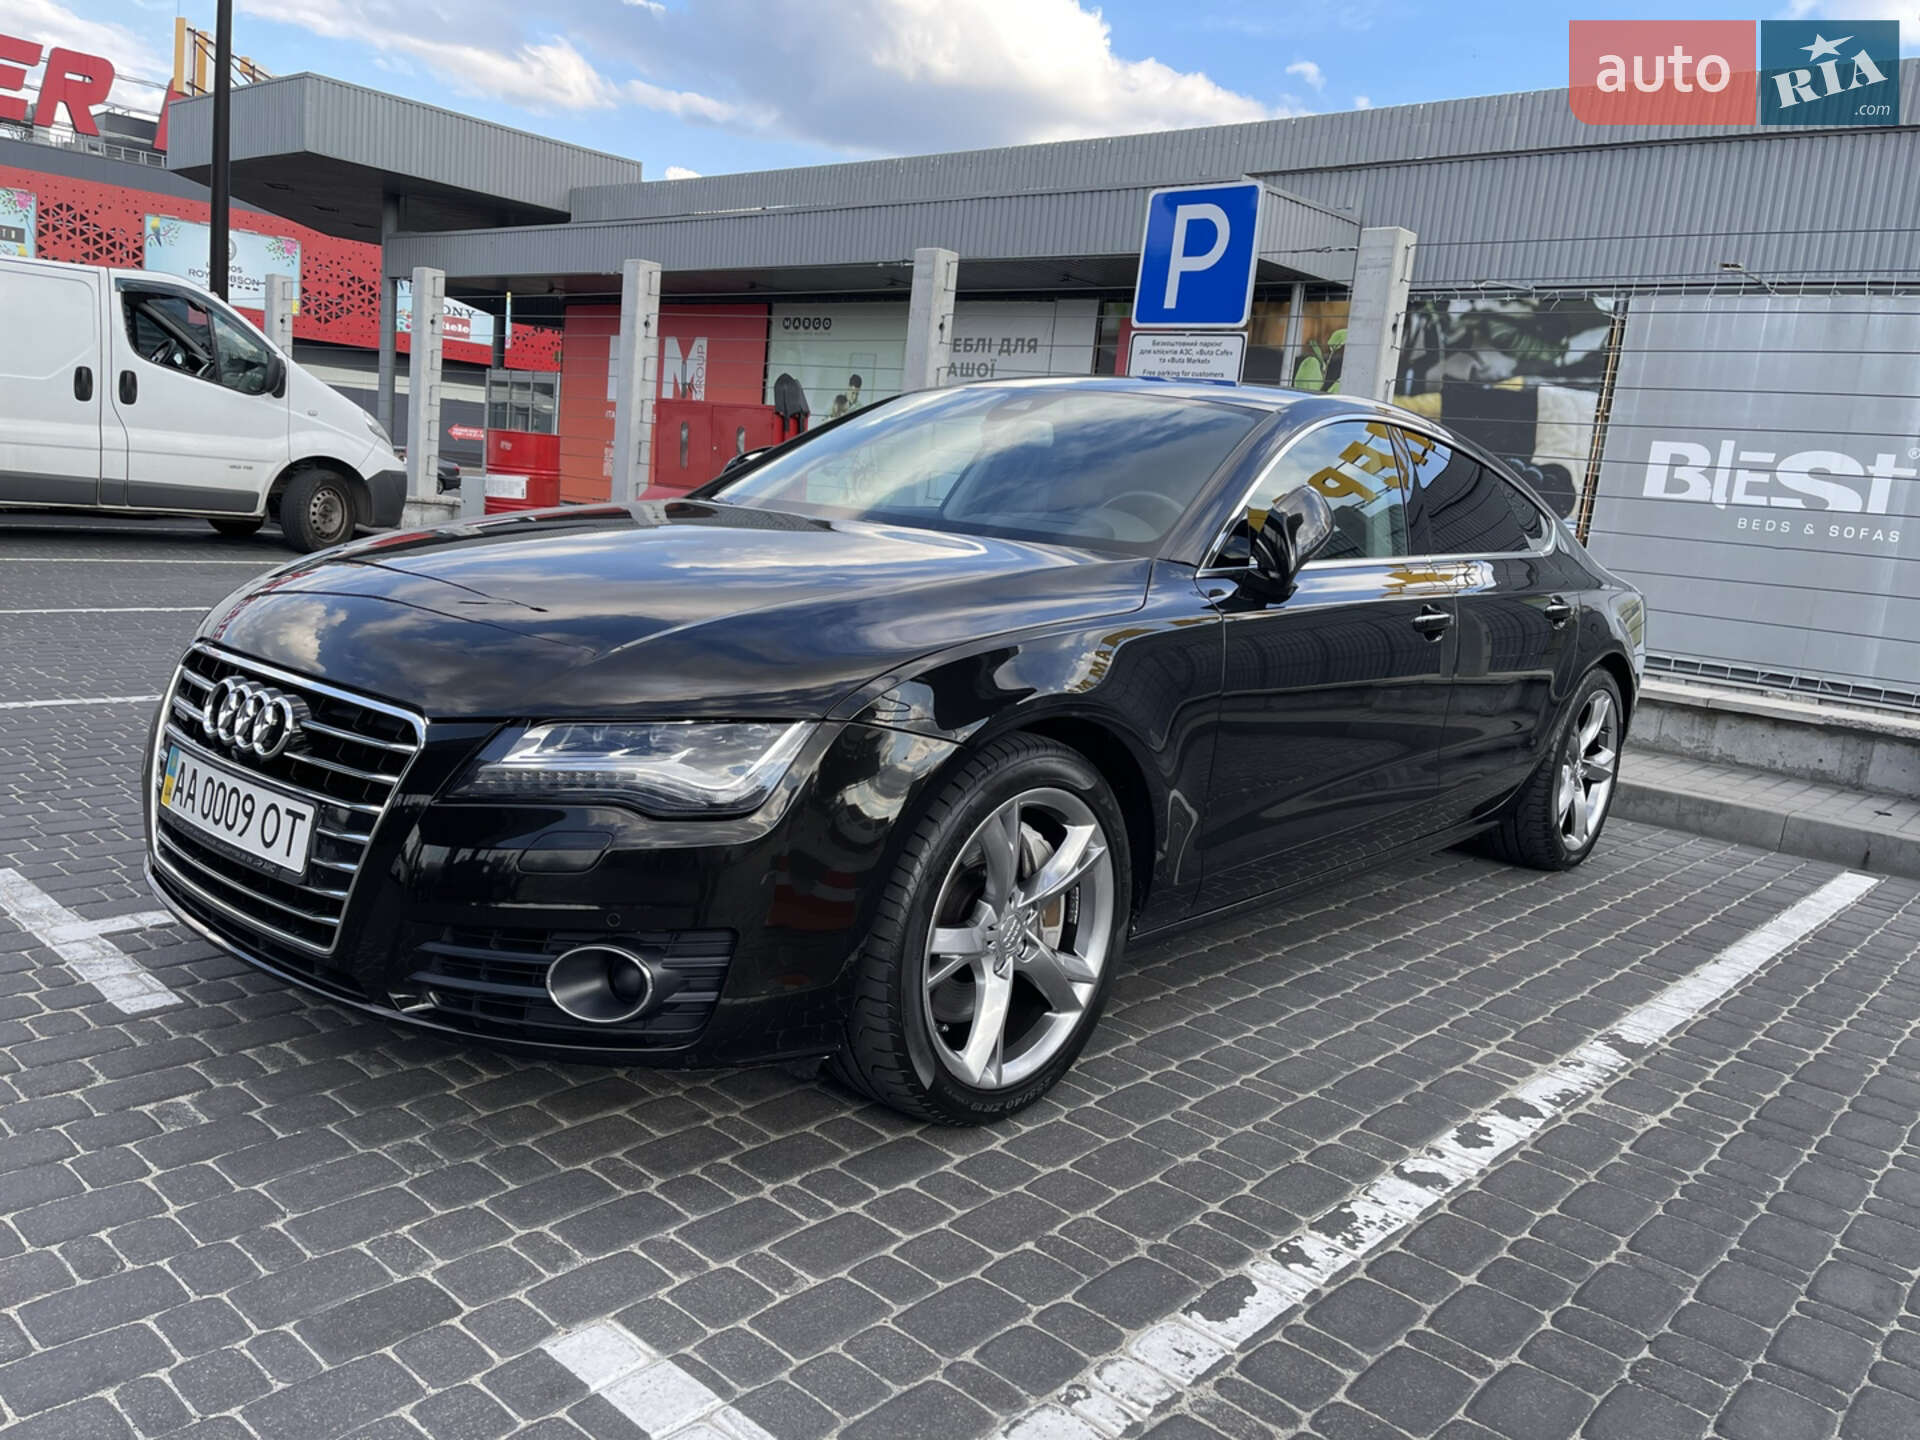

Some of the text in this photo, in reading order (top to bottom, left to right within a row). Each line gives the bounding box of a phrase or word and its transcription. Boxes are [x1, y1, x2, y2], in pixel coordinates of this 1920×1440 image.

[1163, 203, 1231, 309] P
[443, 304, 476, 319] ONY
[952, 337, 1038, 356] ЕБЛІ ДЛЯ
[947, 358, 998, 378] АШОЇ
[1737, 517, 1901, 543] BEDS & SOFAS
[172, 761, 198, 814] AA
[200, 776, 255, 838] 0009
[260, 803, 307, 858] OT
